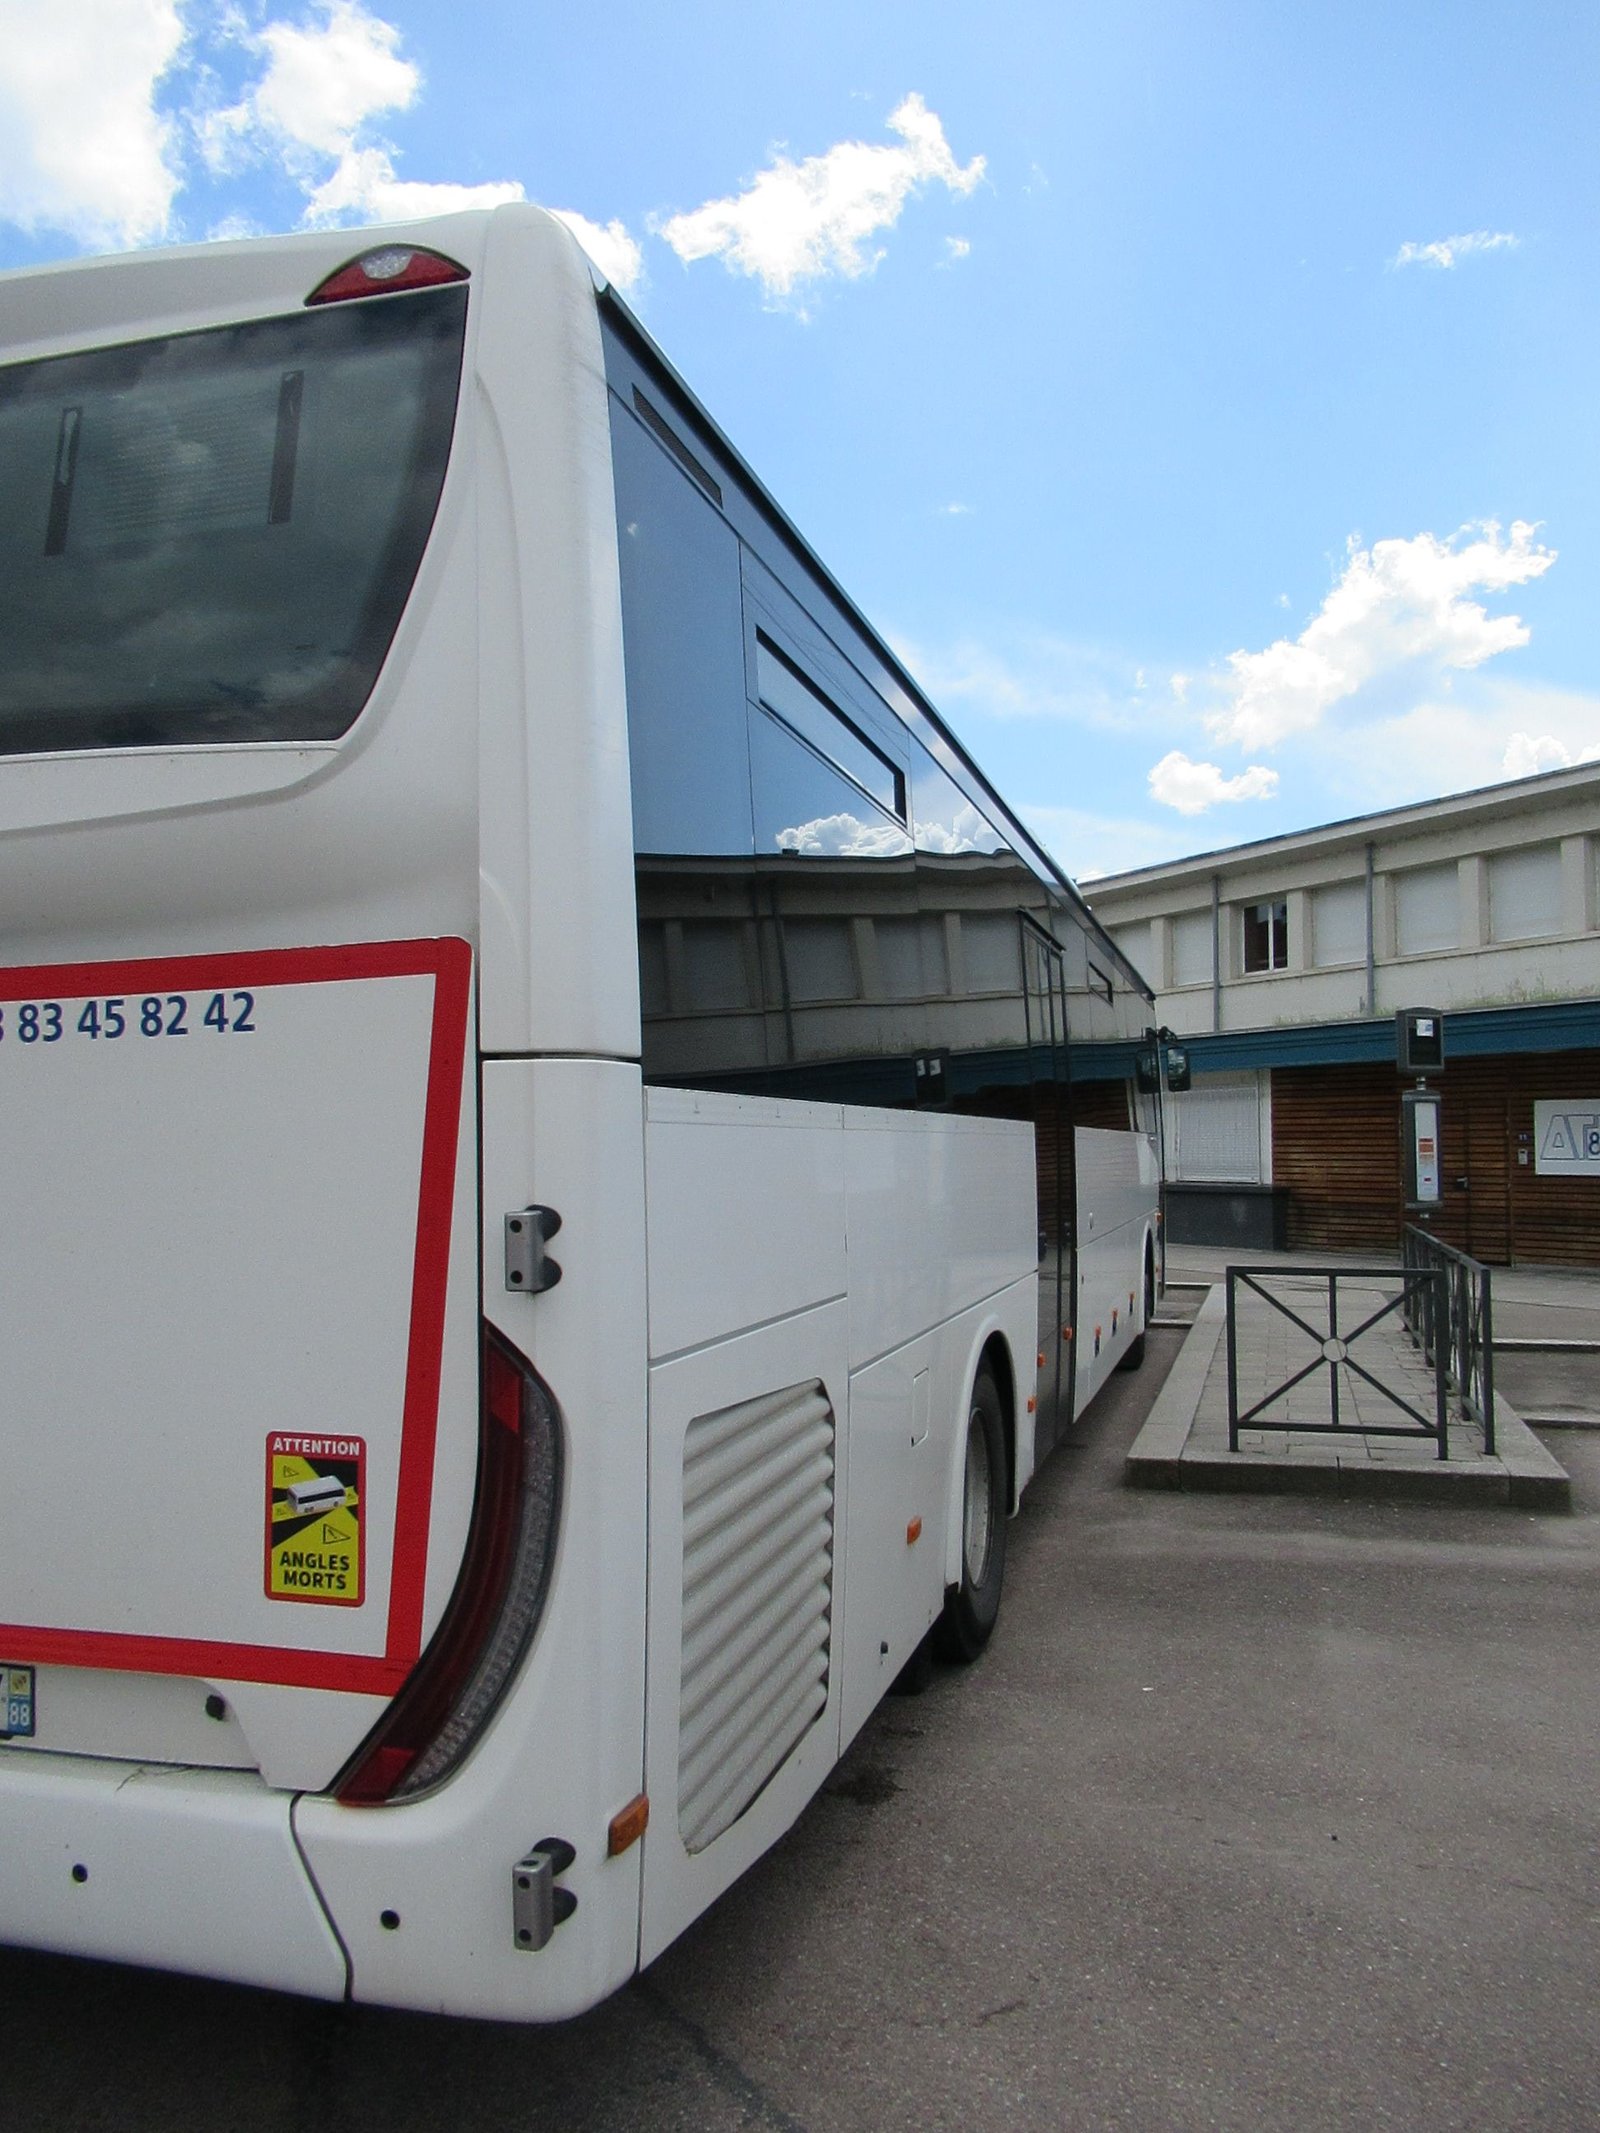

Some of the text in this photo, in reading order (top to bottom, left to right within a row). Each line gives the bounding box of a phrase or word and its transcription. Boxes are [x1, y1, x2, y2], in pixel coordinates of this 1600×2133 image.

[18, 1003, 63, 1043] 83
[77, 999, 126, 1039] 45
[140, 995, 188, 1037] 82
[203, 991, 256, 1033] 42
[1540, 1113, 1600, 1160] AT
[273, 1437, 360, 1456] ATTENTION
[280, 1551, 350, 1571] ANGLES
[283, 1571, 346, 1590] MORTS
[9, 1702, 30, 1726] 88
